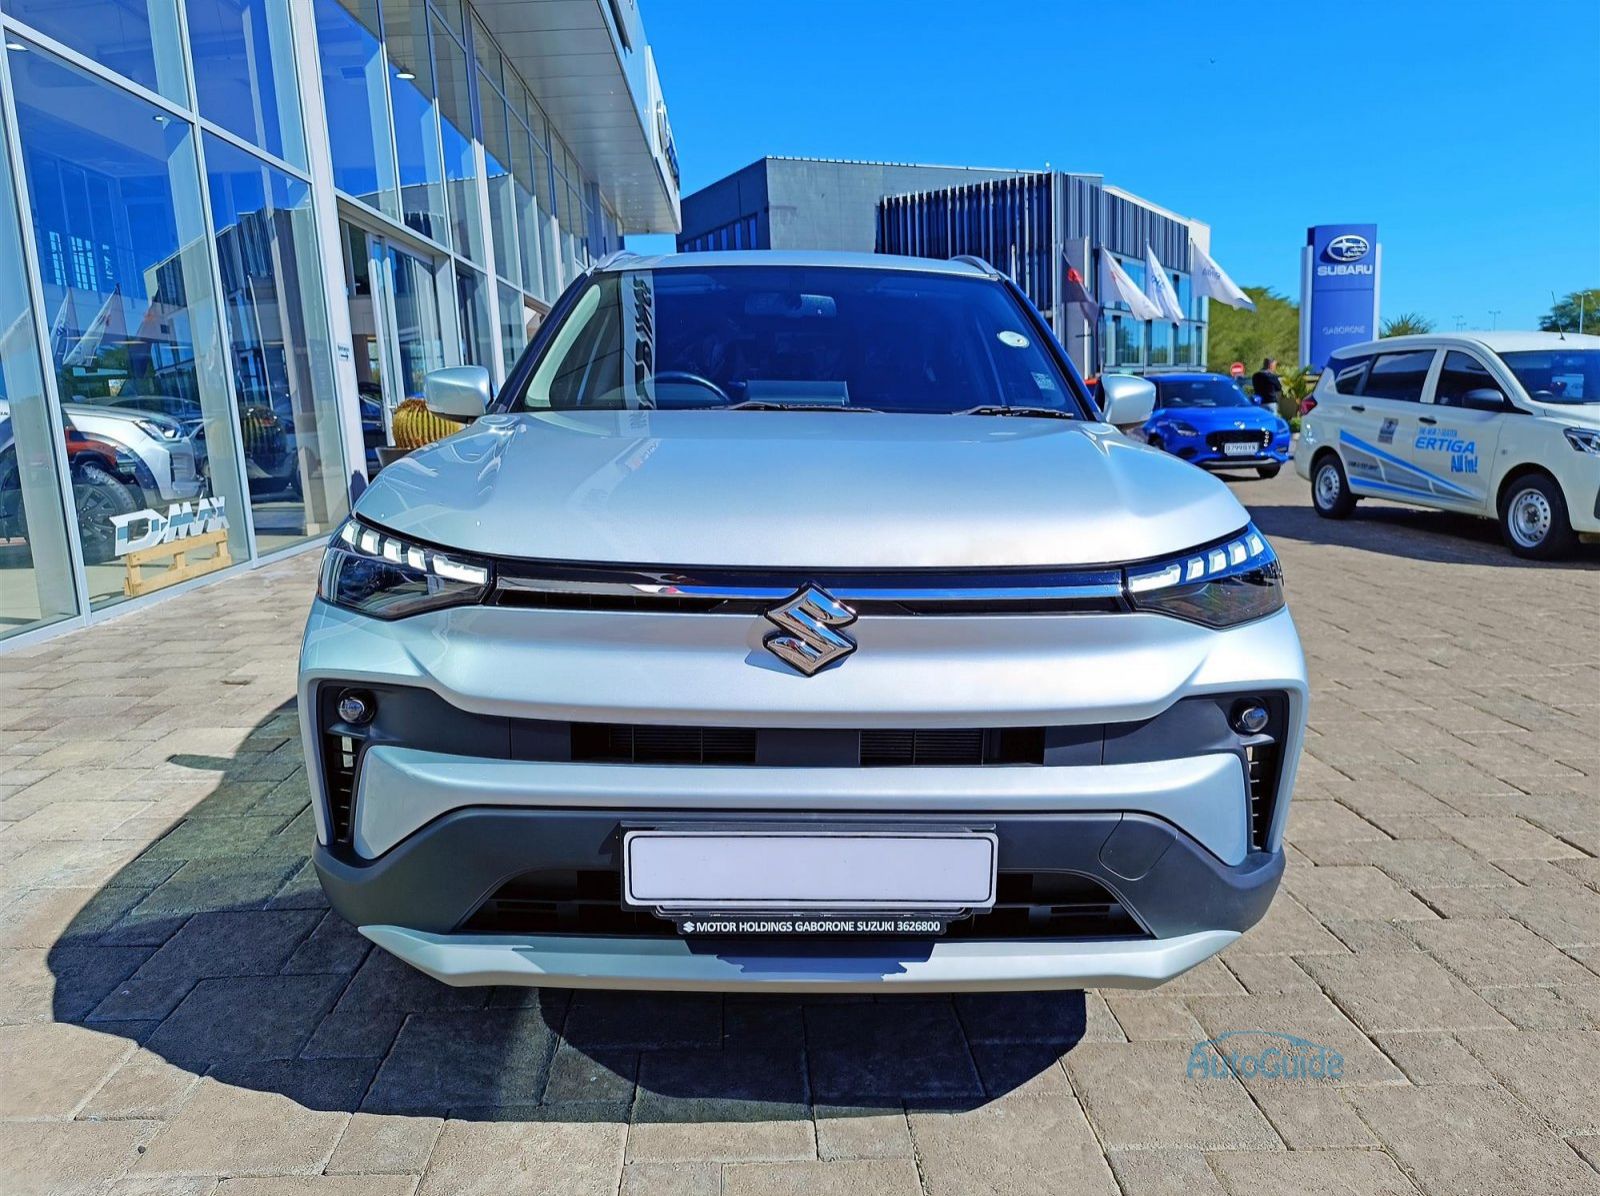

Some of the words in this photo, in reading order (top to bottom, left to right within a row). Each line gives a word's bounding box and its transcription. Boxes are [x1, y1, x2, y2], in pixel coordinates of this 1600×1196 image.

[1317, 264, 1373, 277] SUBARU
[1415, 436, 1475, 455] ERTIGA
[696, 922, 737, 932] MOTOR
[739, 921, 793, 932] HOLDINGS
[795, 921, 854, 932] GABORONE
[857, 921, 894, 932] SUZUKI
[897, 921, 940, 932] 3626800
